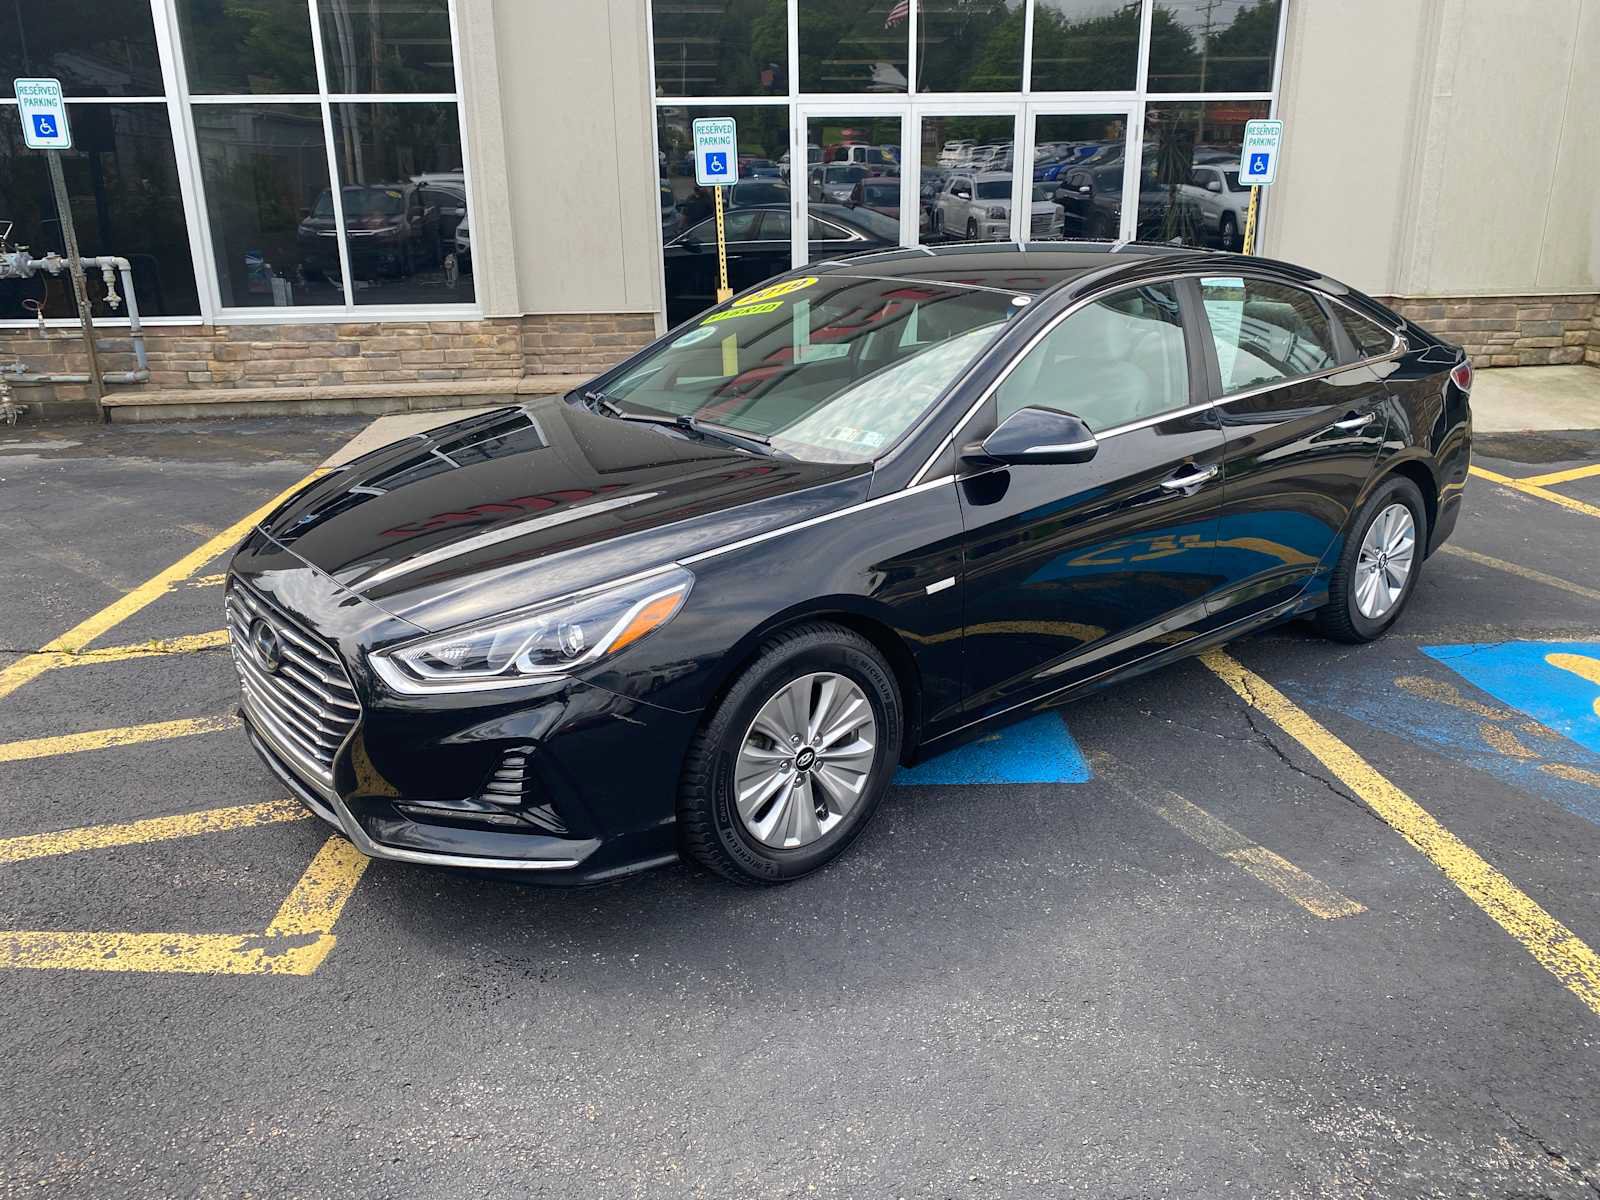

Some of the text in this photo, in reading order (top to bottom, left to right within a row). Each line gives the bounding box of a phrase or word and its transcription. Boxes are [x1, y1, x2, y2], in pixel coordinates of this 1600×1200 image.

[19, 86, 57, 95] RESERVED
[24, 98, 57, 106] PARKING
[697, 125, 732, 134] RESERVED
[1248, 127, 1279, 135] RESERVED
[700, 137, 730, 145] PARKING
[1249, 138, 1276, 146] PARKING
[861, 660, 891, 700] MICHELIN
[724, 830, 763, 870] MICHELIN
